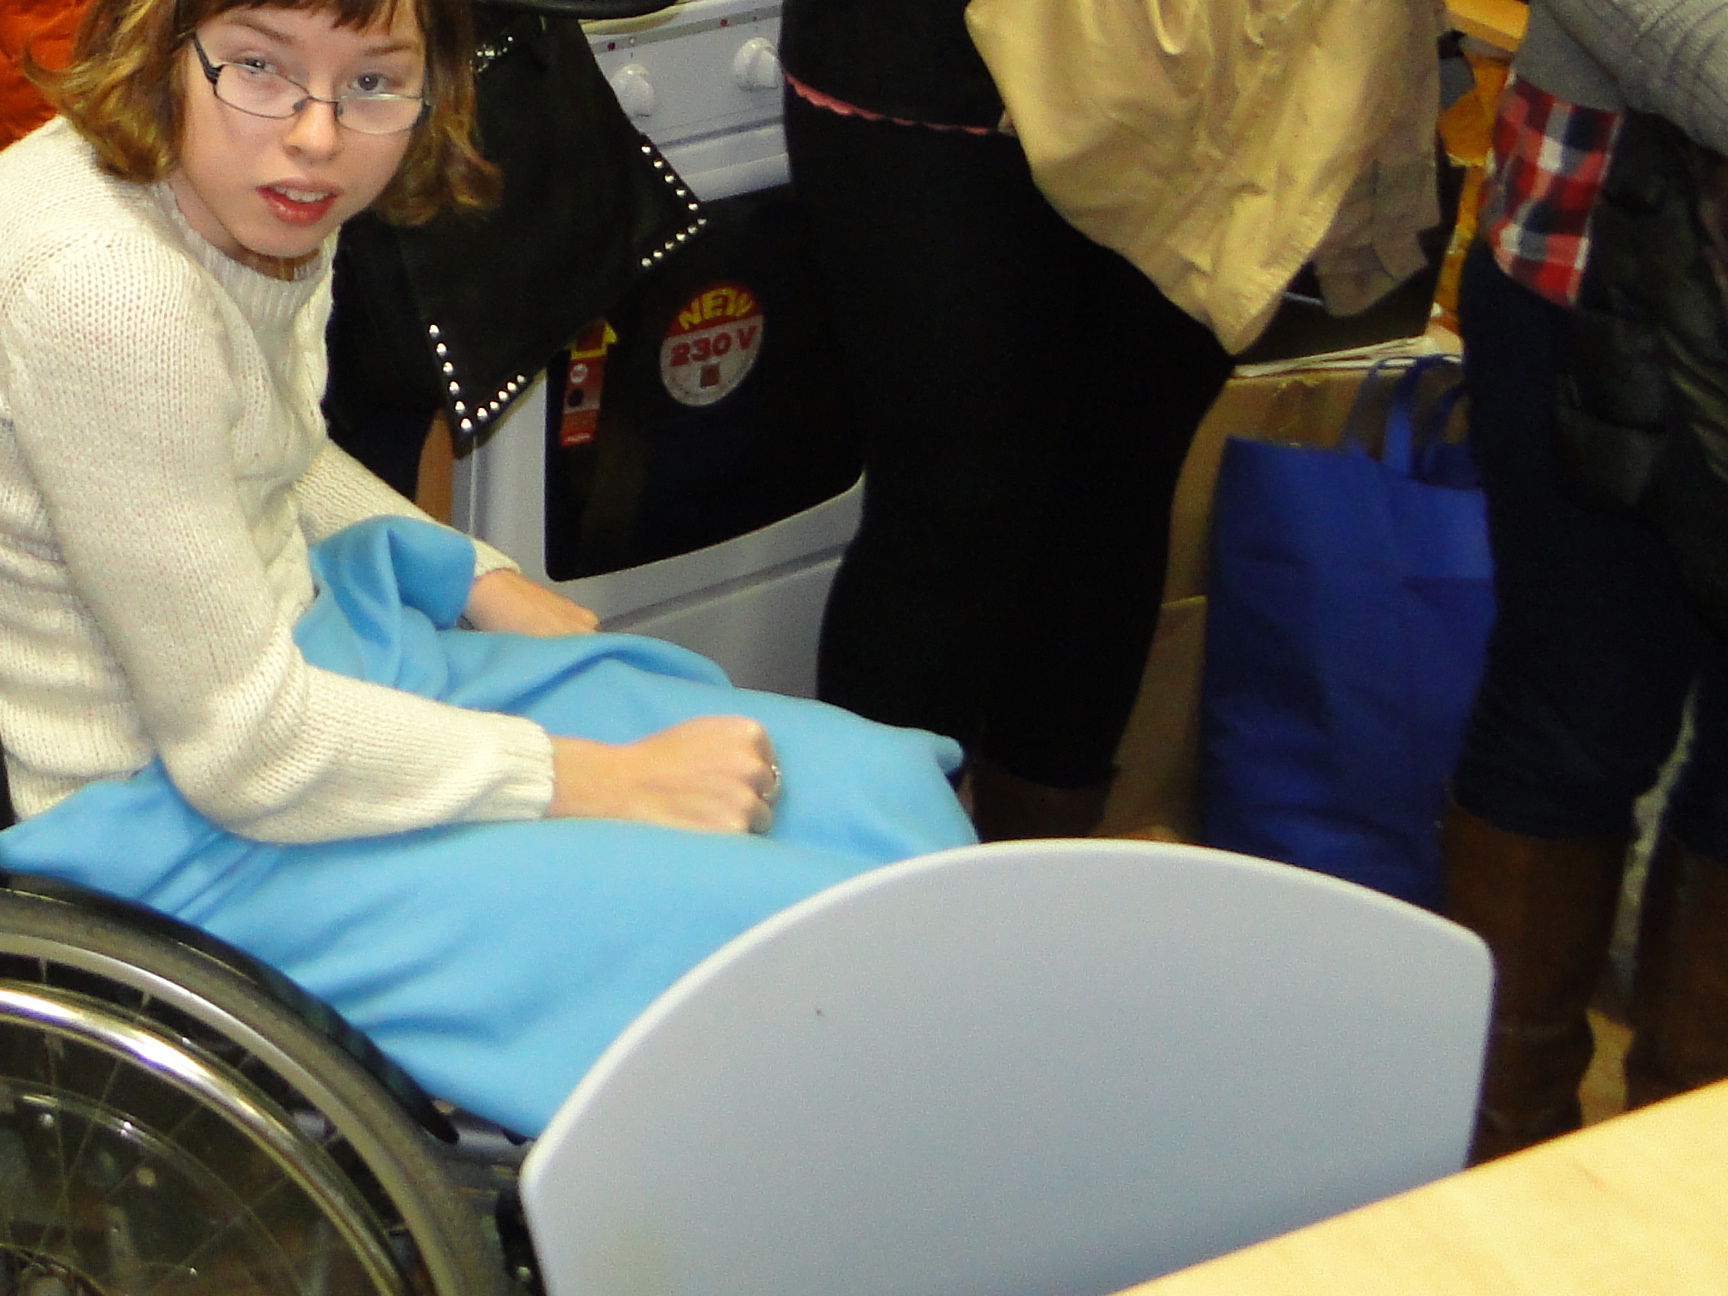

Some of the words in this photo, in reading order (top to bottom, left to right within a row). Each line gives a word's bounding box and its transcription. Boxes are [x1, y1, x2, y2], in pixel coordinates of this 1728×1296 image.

[679, 287, 753, 330] NEW
[669, 332, 732, 368] 230
[737, 325, 757, 350] V
